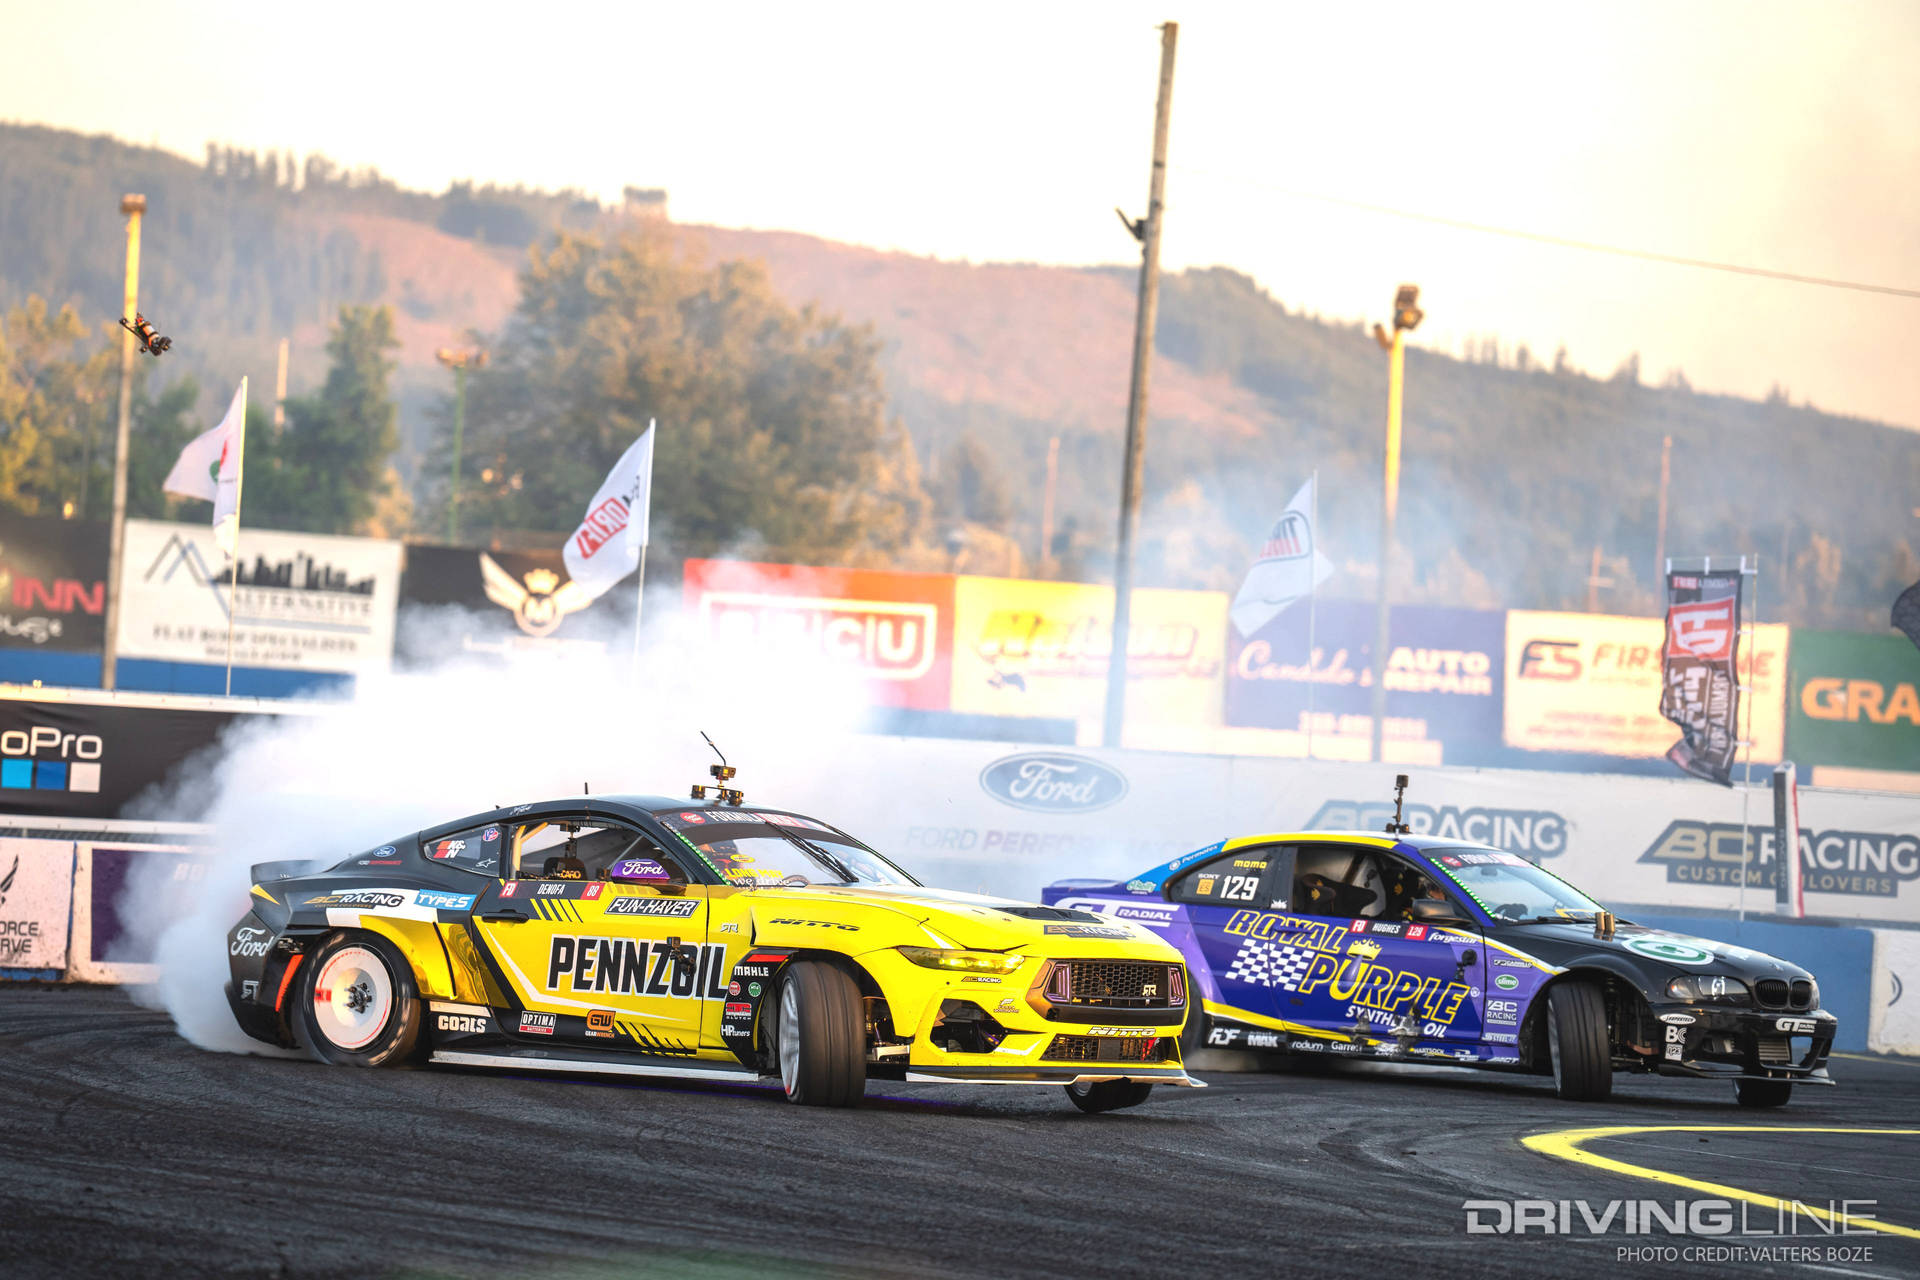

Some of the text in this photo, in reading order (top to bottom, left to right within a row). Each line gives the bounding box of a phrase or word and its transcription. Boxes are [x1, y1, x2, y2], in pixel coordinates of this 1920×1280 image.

[1388, 647, 1490, 676] AUTO
[1383, 670, 1492, 696] REPAIR
[1010, 760, 1100, 803] Ford
[904, 826, 978, 851] FORD
[1408, 810, 1561, 852] RACING
[1653, 827, 1754, 864] BC
[621, 860, 664, 876] Ford
[1233, 859, 1268, 869] momo
[537, 883, 566, 896] DENOFA
[587, 885, 600, 897] 88
[1220, 875, 1260, 901] 129
[1677, 863, 1893, 894] CUSTOM CILOVERS
[340, 892, 403, 907] RACING
[609, 898, 695, 915] FUN-HAVER
[1118, 908, 1173, 921] RADIAL
[231, 926, 276, 957] Ford
[1224, 909, 1349, 954] ROYAL
[1372, 922, 1402, 935] HUGHES
[1408, 926, 1424, 938] 129
[547, 936, 728, 1001] PENNZOIL
[734, 965, 770, 977] MAHLE
[1299, 954, 1471, 1025] PURPLE
[522, 1013, 555, 1027] OPTIMA
[1345, 1004, 1448, 1038] SYNTHET OIL
[1487, 1011, 1517, 1021] RACING
[1088, 1026, 1157, 1036] NITTO
